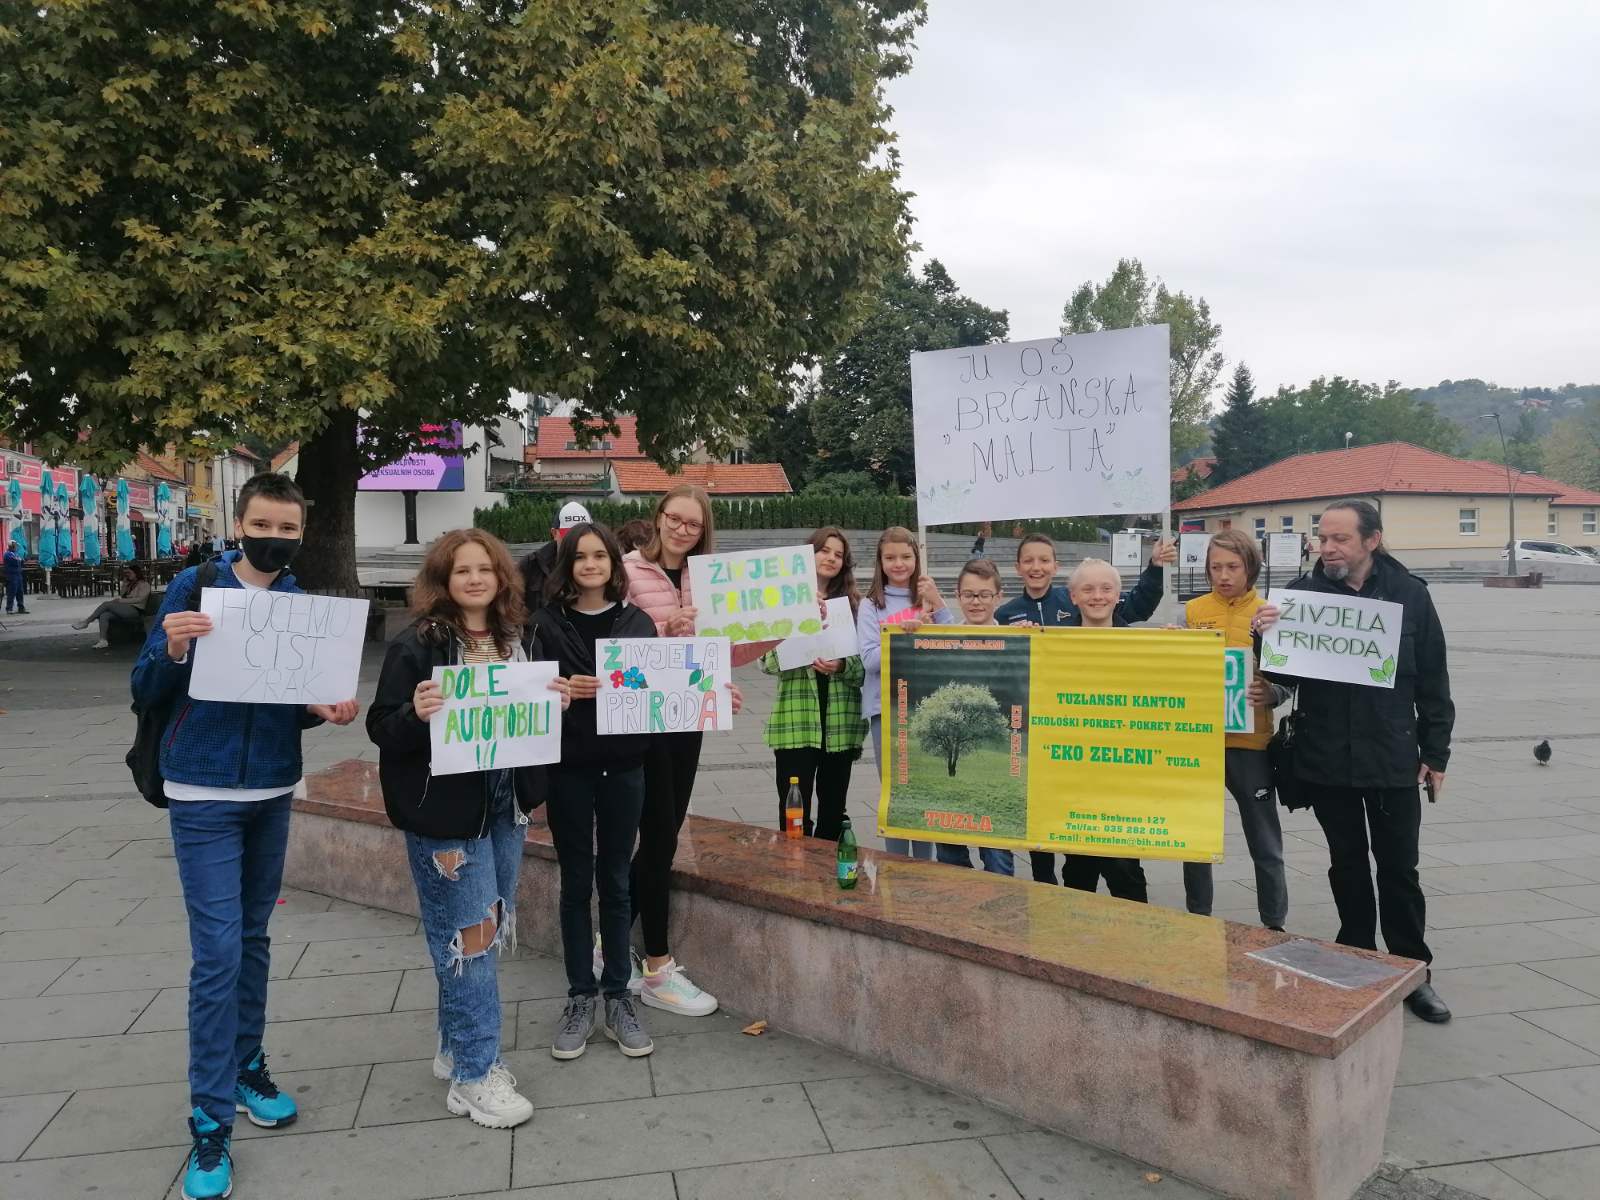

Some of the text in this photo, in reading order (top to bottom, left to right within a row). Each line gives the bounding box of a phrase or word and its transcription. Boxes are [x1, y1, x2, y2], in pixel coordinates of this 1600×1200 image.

[958, 338, 1074, 384] JU OŠ
[954, 372, 1143, 433] BRČANSKA
[564, 515, 587, 523] SOX
[710, 582, 813, 615] PRIRODA
[1279, 597, 1386, 634] ŽIVJELA
[604, 640, 719, 671] ŽIVJELA
[1277, 630, 1382, 660] PRIRODA
[236, 668, 323, 704] ZRAK
[441, 665, 509, 700] DOLE
[606, 691, 718, 733] PRIRODA
[1056, 692, 1187, 709] TUZLANSKI KANTON
[444, 700, 551, 745] AUTOMOBILI
[1129, 720, 1172, 732] POKRET
[1174, 722, 1213, 734] ZELENI
[1165, 756, 1201, 768] TUZLA
[923, 809, 993, 833] TUZLA
[1104, 825, 1123, 833] 035
[1147, 816, 1166, 825] 127
